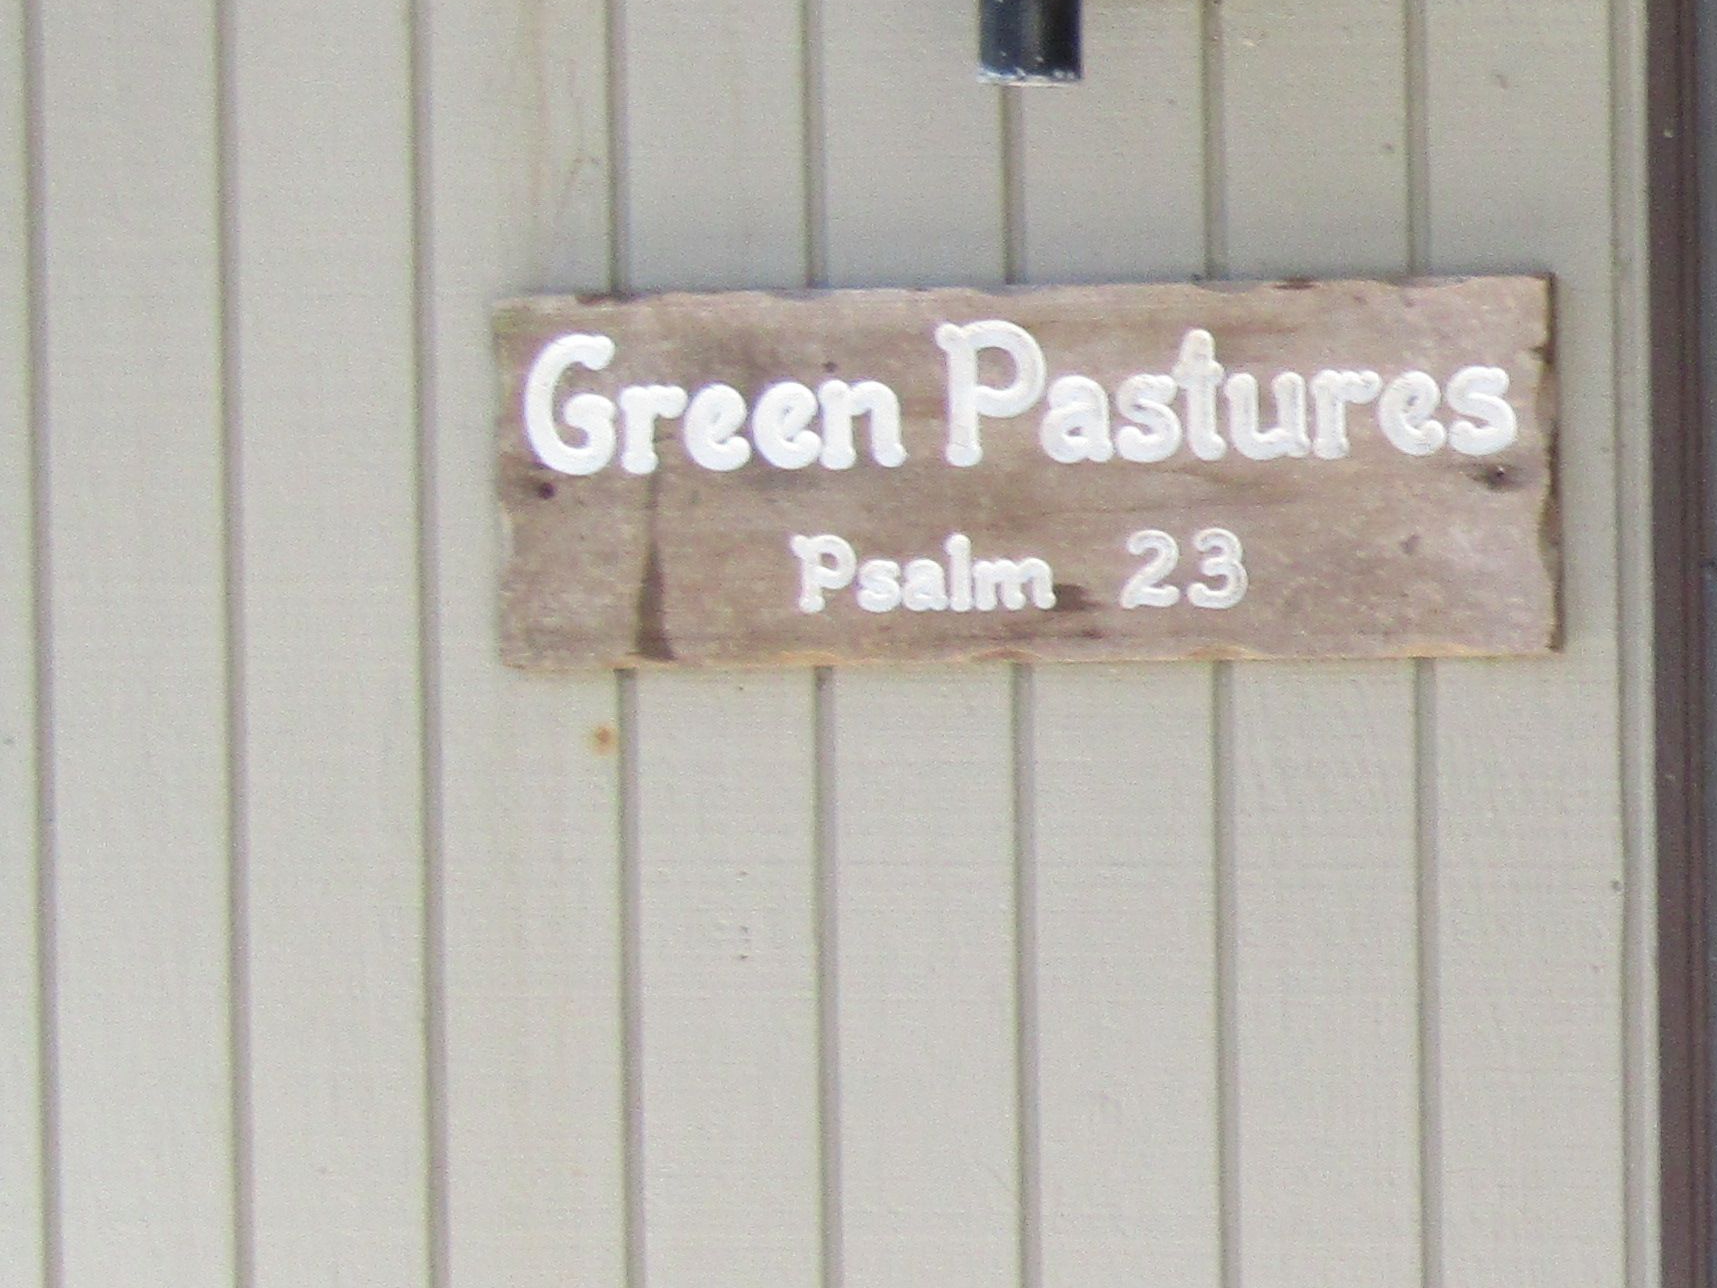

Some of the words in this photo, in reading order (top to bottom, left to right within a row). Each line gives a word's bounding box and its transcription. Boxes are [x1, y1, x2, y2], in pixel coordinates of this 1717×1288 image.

[523, 332, 908, 476] Green
[935, 318, 1520, 468] Pastures
[789, 532, 1056, 614] Psalm
[1119, 526, 1248, 610] 23
